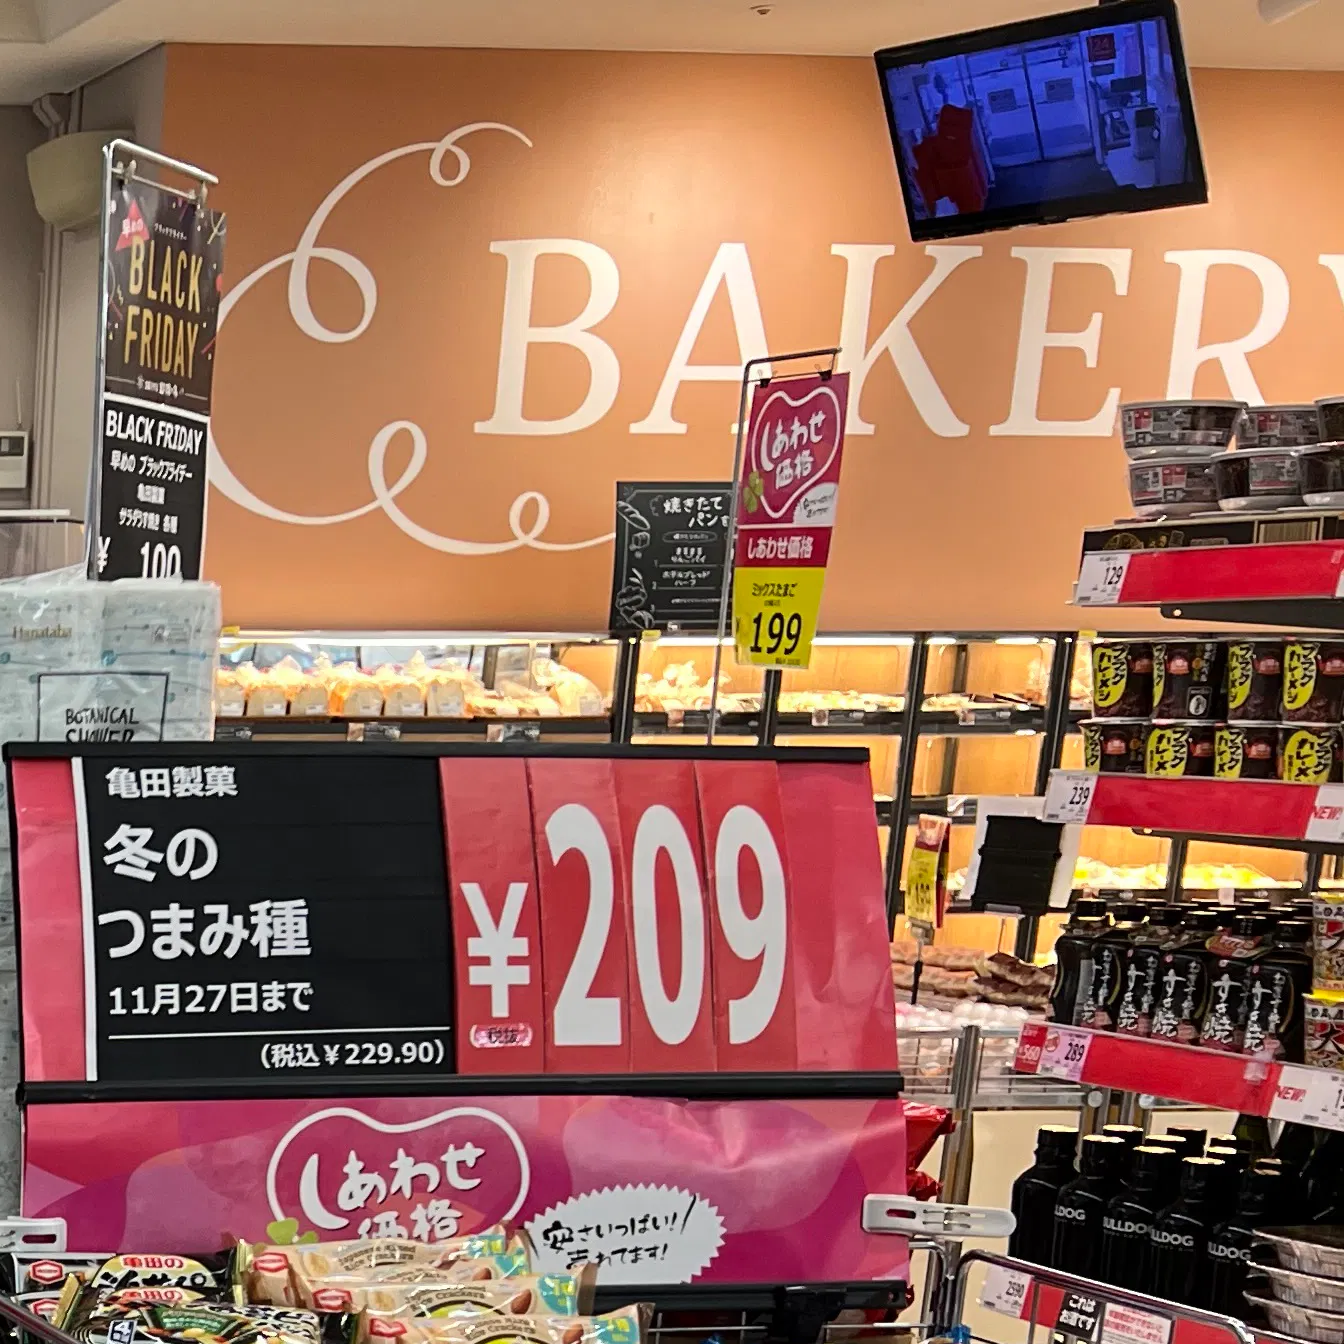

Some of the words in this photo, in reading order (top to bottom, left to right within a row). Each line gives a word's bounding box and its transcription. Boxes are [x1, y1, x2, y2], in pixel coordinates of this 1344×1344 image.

[128, 235, 203, 314] BLACK
[123, 304, 199, 380] FRIDAY
[472, 236, 1344, 438] BAKER
[105, 409, 156, 447] BLACK
[155, 420, 204, 456] FRIDAY
[760, 410, 827, 472] しあわせ
[775, 450, 815, 490] 価格
[663, 495, 724, 515] 焼きたて
[139, 541, 183, 580] 100
[747, 535, 814, 560] しあわせ価格
[1102, 564, 1124, 587] 129
[750, 611, 803, 656] 199
[65, 705, 140, 727] BOTANICAL
[105, 766, 239, 801] 亀田製菓
[1068, 786, 1091, 807] 239
[102, 824, 219, 884] 冬の
[98, 898, 312, 960] つまみ種
[459, 881, 532, 1018] ¥
[543, 801, 790, 1048] 209
[108, 980, 314, 1018] 11月27日まで
[298, 1140, 486, 1230] しあわせ
